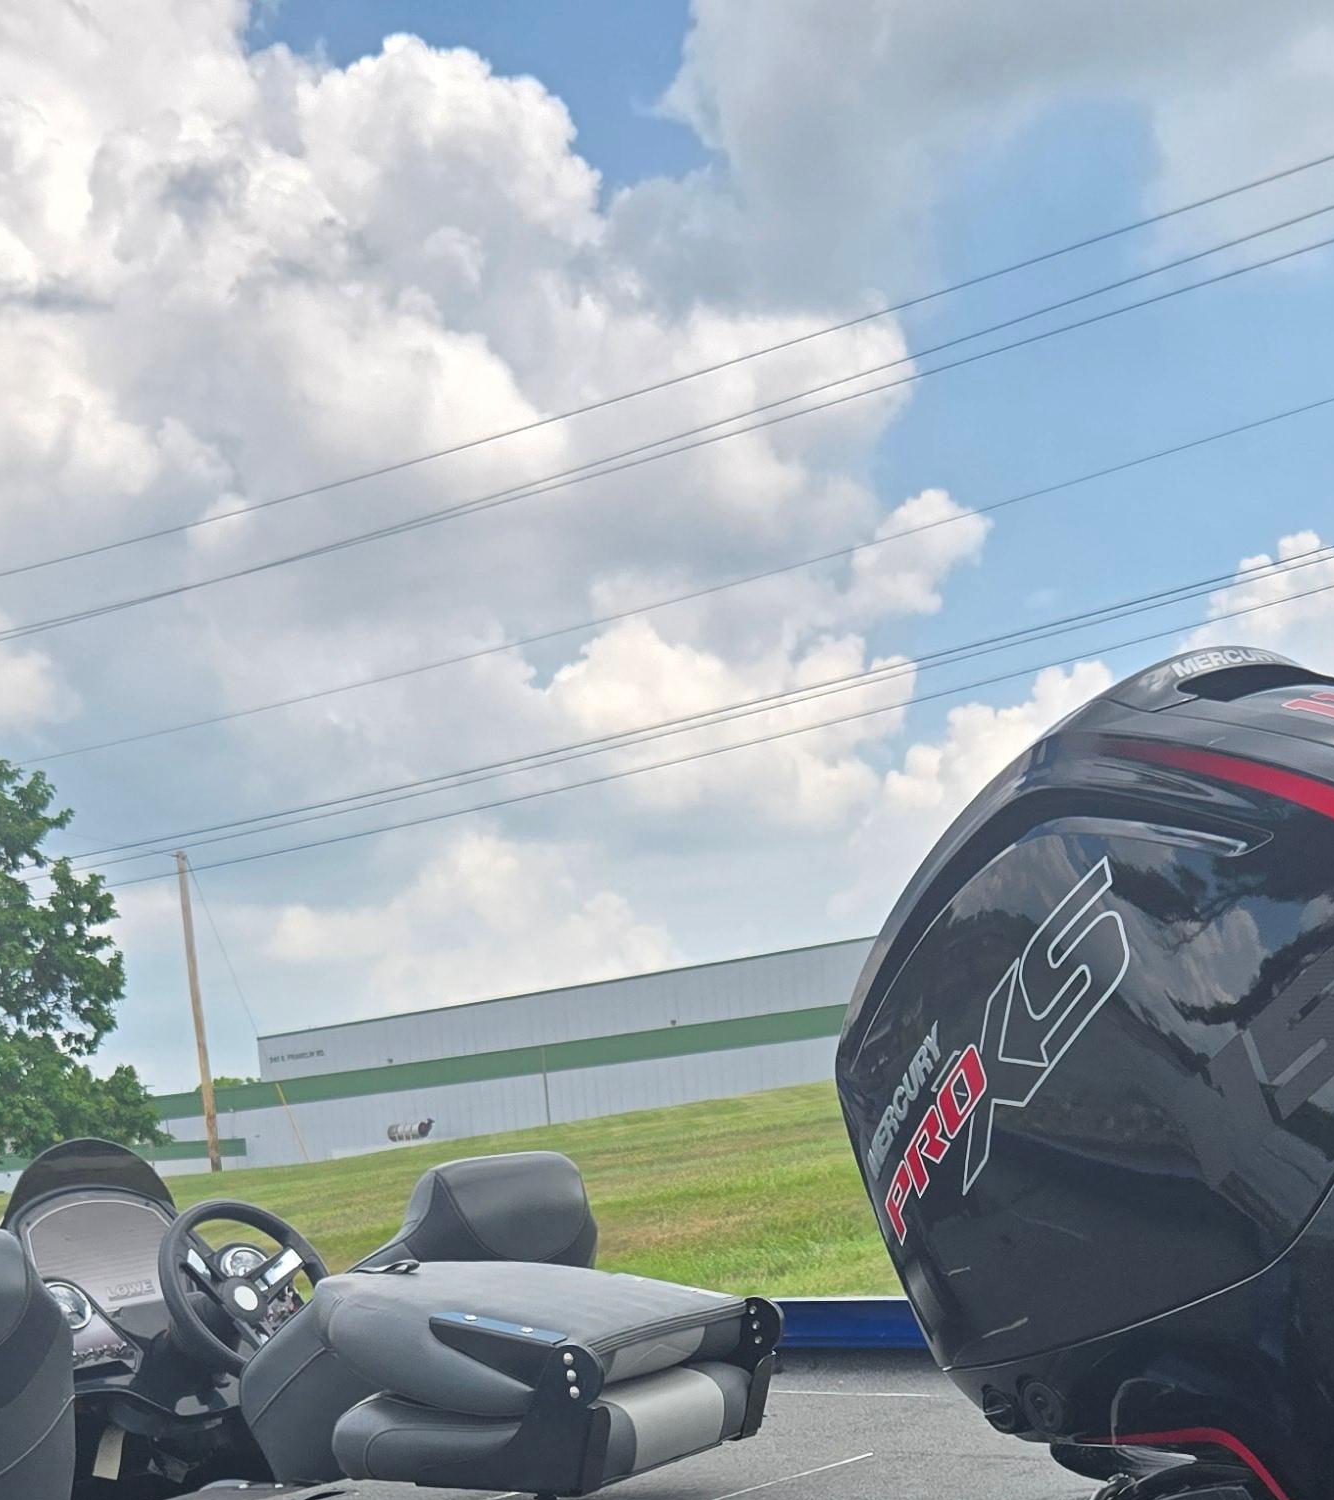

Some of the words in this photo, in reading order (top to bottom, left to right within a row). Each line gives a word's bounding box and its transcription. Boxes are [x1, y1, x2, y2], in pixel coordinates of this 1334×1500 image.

[1171, 649, 1277, 678] MERCUR
[868, 1020, 941, 1180] MERCURY
[931, 855, 1130, 1196] XS
[885, 1043, 987, 1246] PRO
[106, 1279, 155, 1301] LOWE
